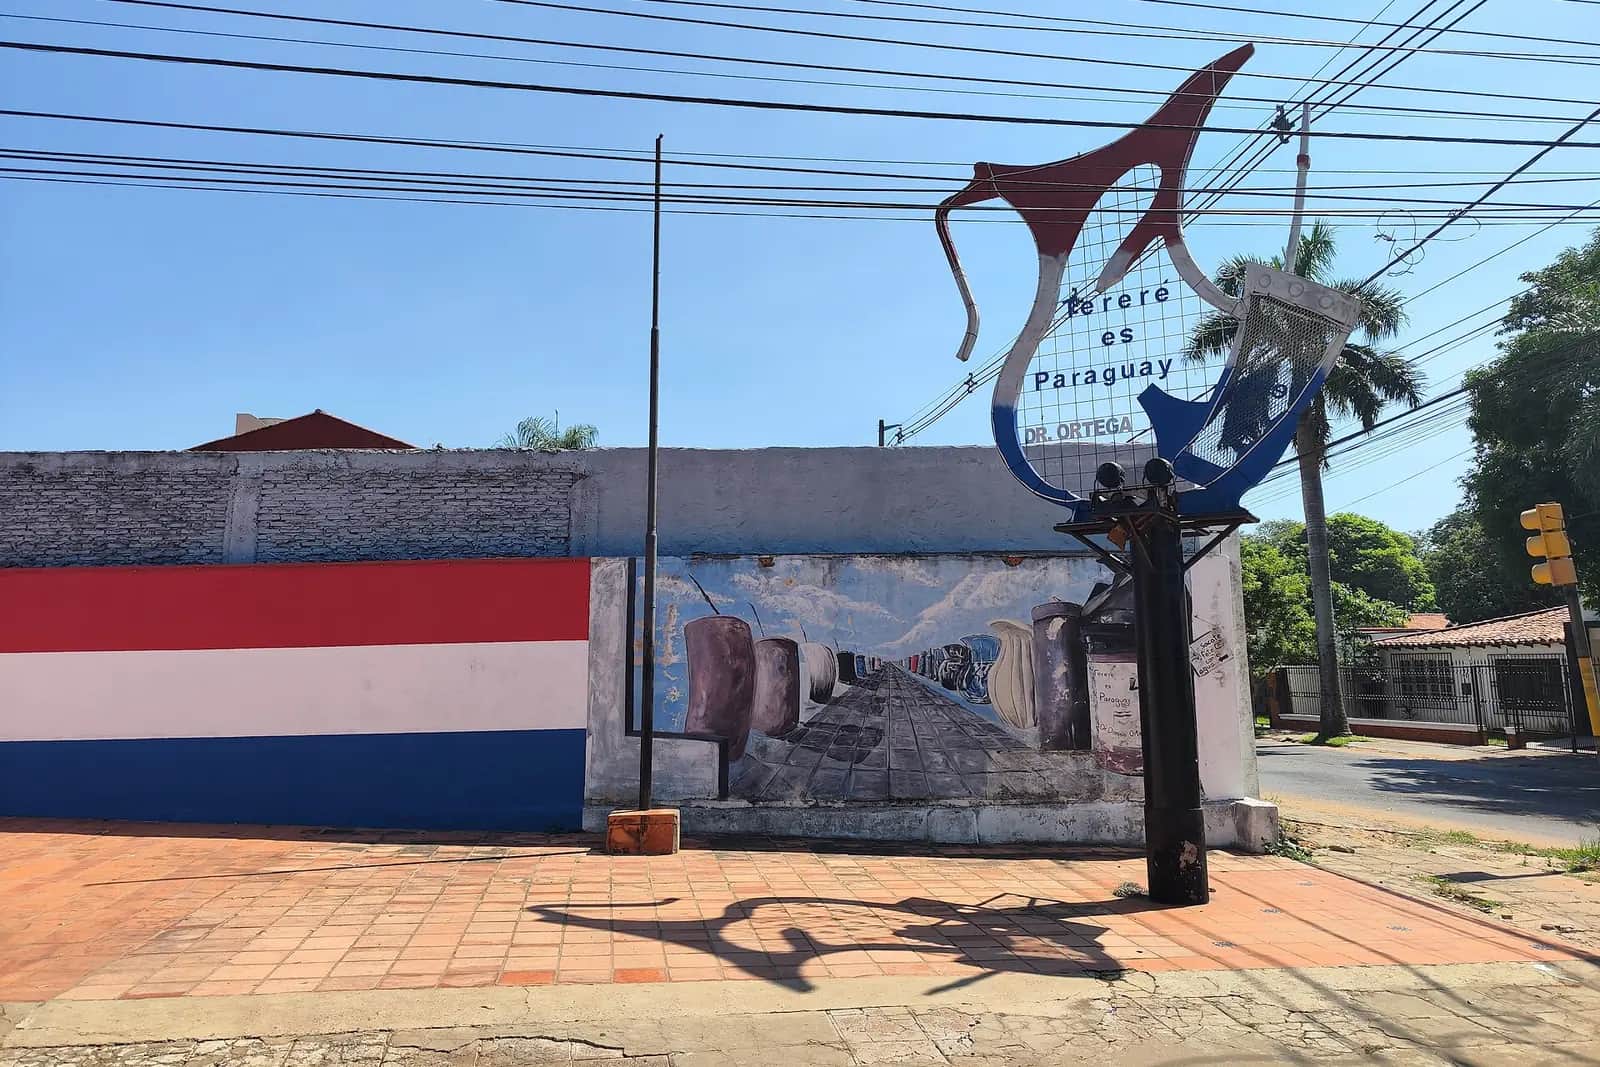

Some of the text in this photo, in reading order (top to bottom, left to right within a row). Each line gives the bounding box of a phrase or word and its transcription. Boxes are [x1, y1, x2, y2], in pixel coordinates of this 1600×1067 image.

[1102, 327, 1134, 346] es
[1035, 358, 1173, 392] Paraguay
[1025, 416, 1132, 442] DR. ORTEGA
